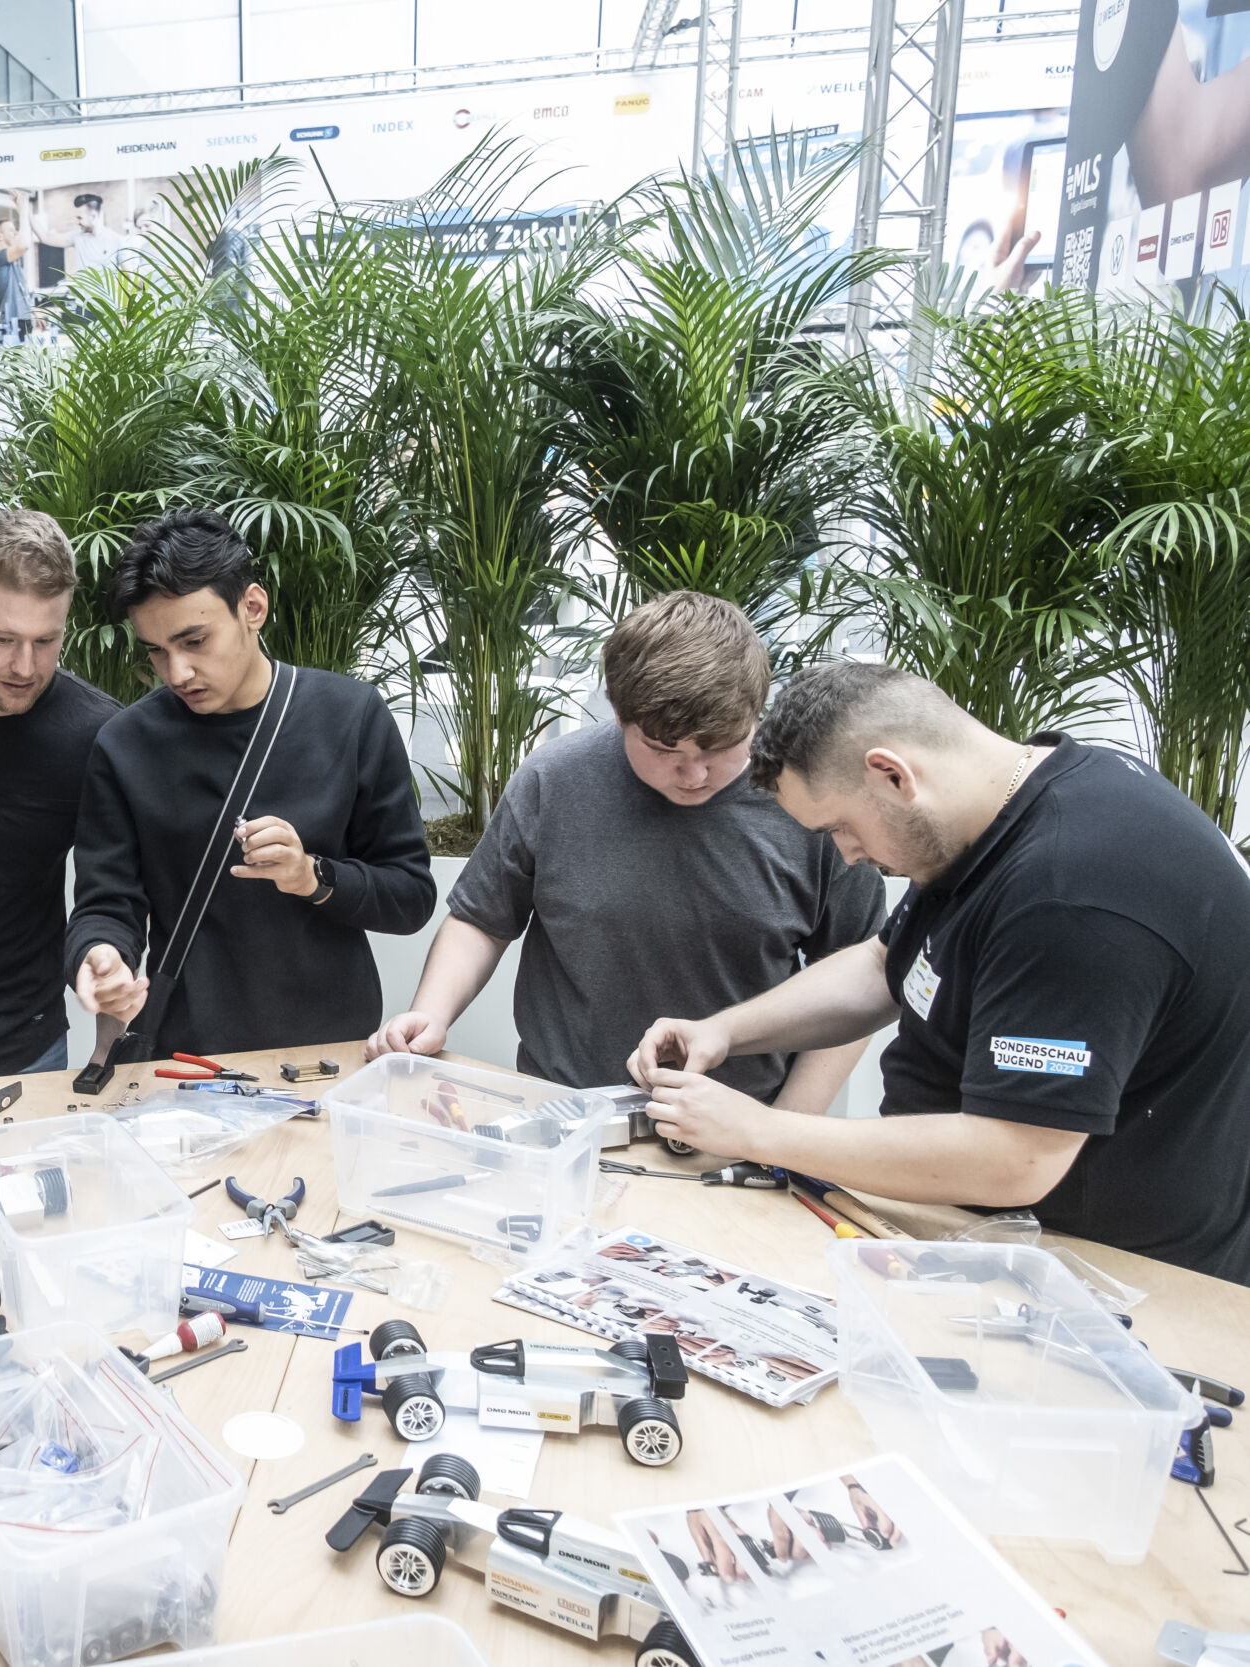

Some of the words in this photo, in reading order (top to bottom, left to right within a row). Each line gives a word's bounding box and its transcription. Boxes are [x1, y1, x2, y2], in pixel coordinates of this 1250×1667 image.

[1045, 65, 1075, 74] KUN
[820, 81, 867, 94] WEILE
[615, 98, 650, 107] FANUC
[533, 105, 569, 120] emco
[372, 120, 414, 133] INDEX
[206, 134, 258, 147] SIEMENS
[116, 141, 177, 155] HEIDENHAIN
[52, 151, 74, 160] HORN
[1073, 153, 1102, 199] MLS
[1212, 216, 1228, 243] DB
[993, 1040, 1086, 1063] SONDERSCHAU
[997, 1053, 1044, 1069] JUGEND
[1049, 1062, 1076, 1074] 2022
[558, 1550, 582, 1562] DMG
[583, 1557, 610, 1570] MORI
[557, 1613, 594, 1632] WEILER
